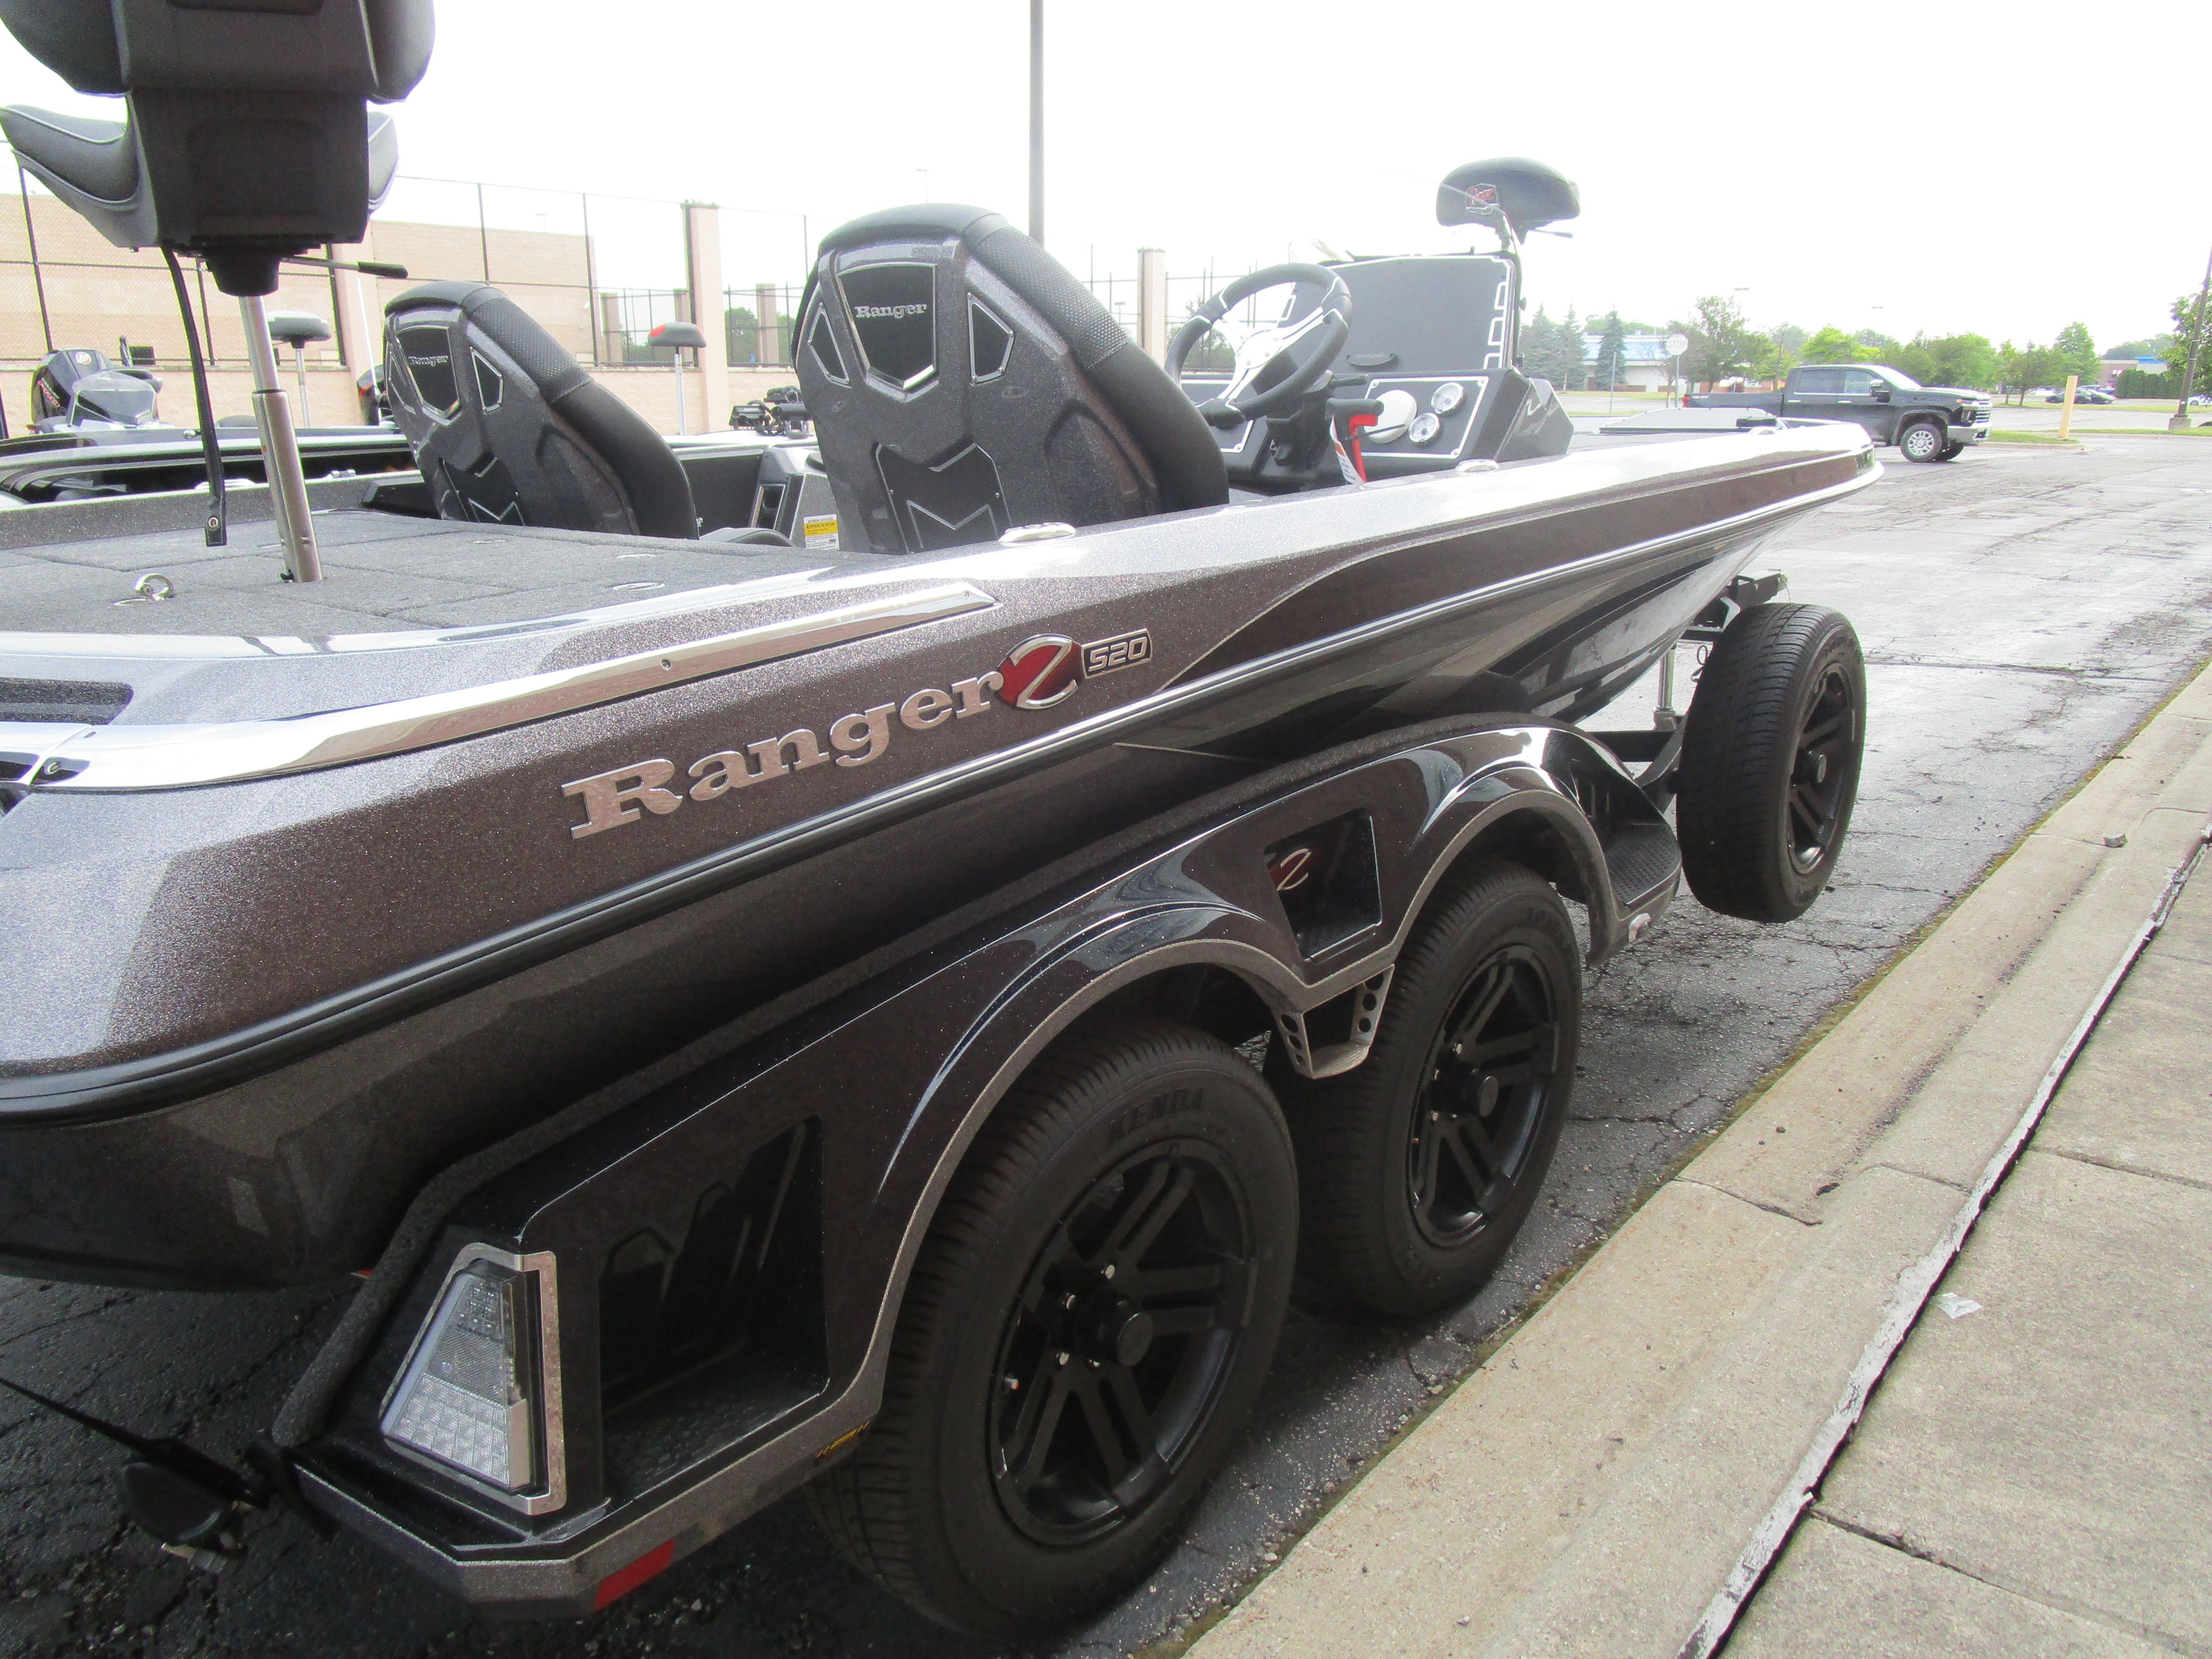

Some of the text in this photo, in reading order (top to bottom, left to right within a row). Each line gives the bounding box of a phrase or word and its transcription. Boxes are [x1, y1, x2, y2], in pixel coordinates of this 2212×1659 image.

[855, 304, 927, 319] Ranger
[562, 671, 1004, 839] Ranger
[1088, 636, 1148, 672] 520
[1107, 1086, 1205, 1144] KENDA
